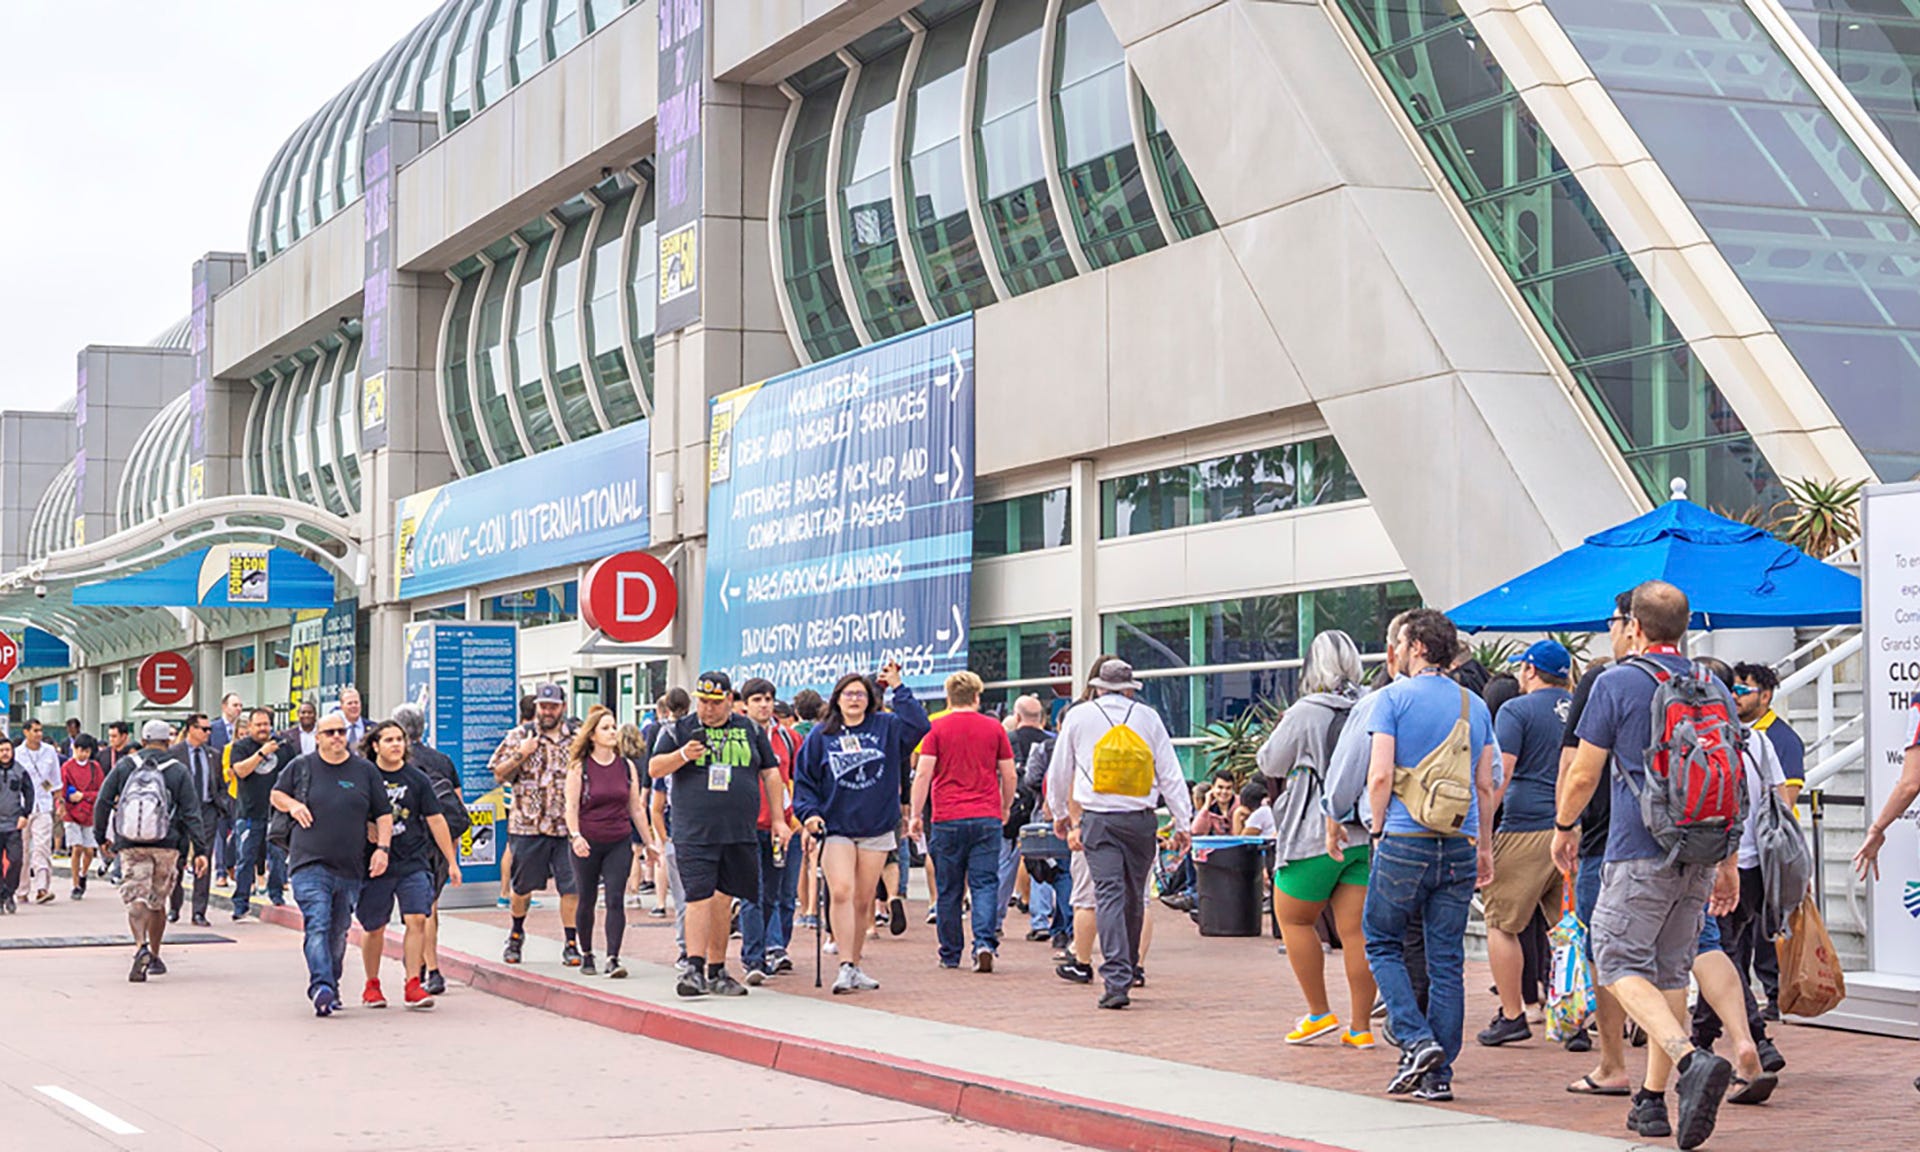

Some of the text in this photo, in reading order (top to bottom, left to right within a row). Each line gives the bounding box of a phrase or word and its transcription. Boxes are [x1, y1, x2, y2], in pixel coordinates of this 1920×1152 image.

[789, 367, 868, 416] VOLUNTEERS
[737, 435, 765, 467] DEAF
[768, 428, 792, 459] AND
[860, 387, 927, 434] SERVICES
[732, 447, 928, 520] ATTENDEE BADGE PICK-UP AND
[429, 515, 505, 567] COMIC-CON
[511, 478, 643, 550] INTERNATIONAL
[747, 491, 905, 550] COMPLIMENTARY PASSES
[242, 557, 267, 570] CON
[747, 550, 902, 603] BAGS/BOOKS/LANYARDS
[1896, 553, 1907, 568] To
[616, 571, 657, 622] D
[741, 608, 906, 657] INDUSTRY REGISTRATION:
[1881, 635, 1911, 651] Grand
[155, 663, 177, 693] E
